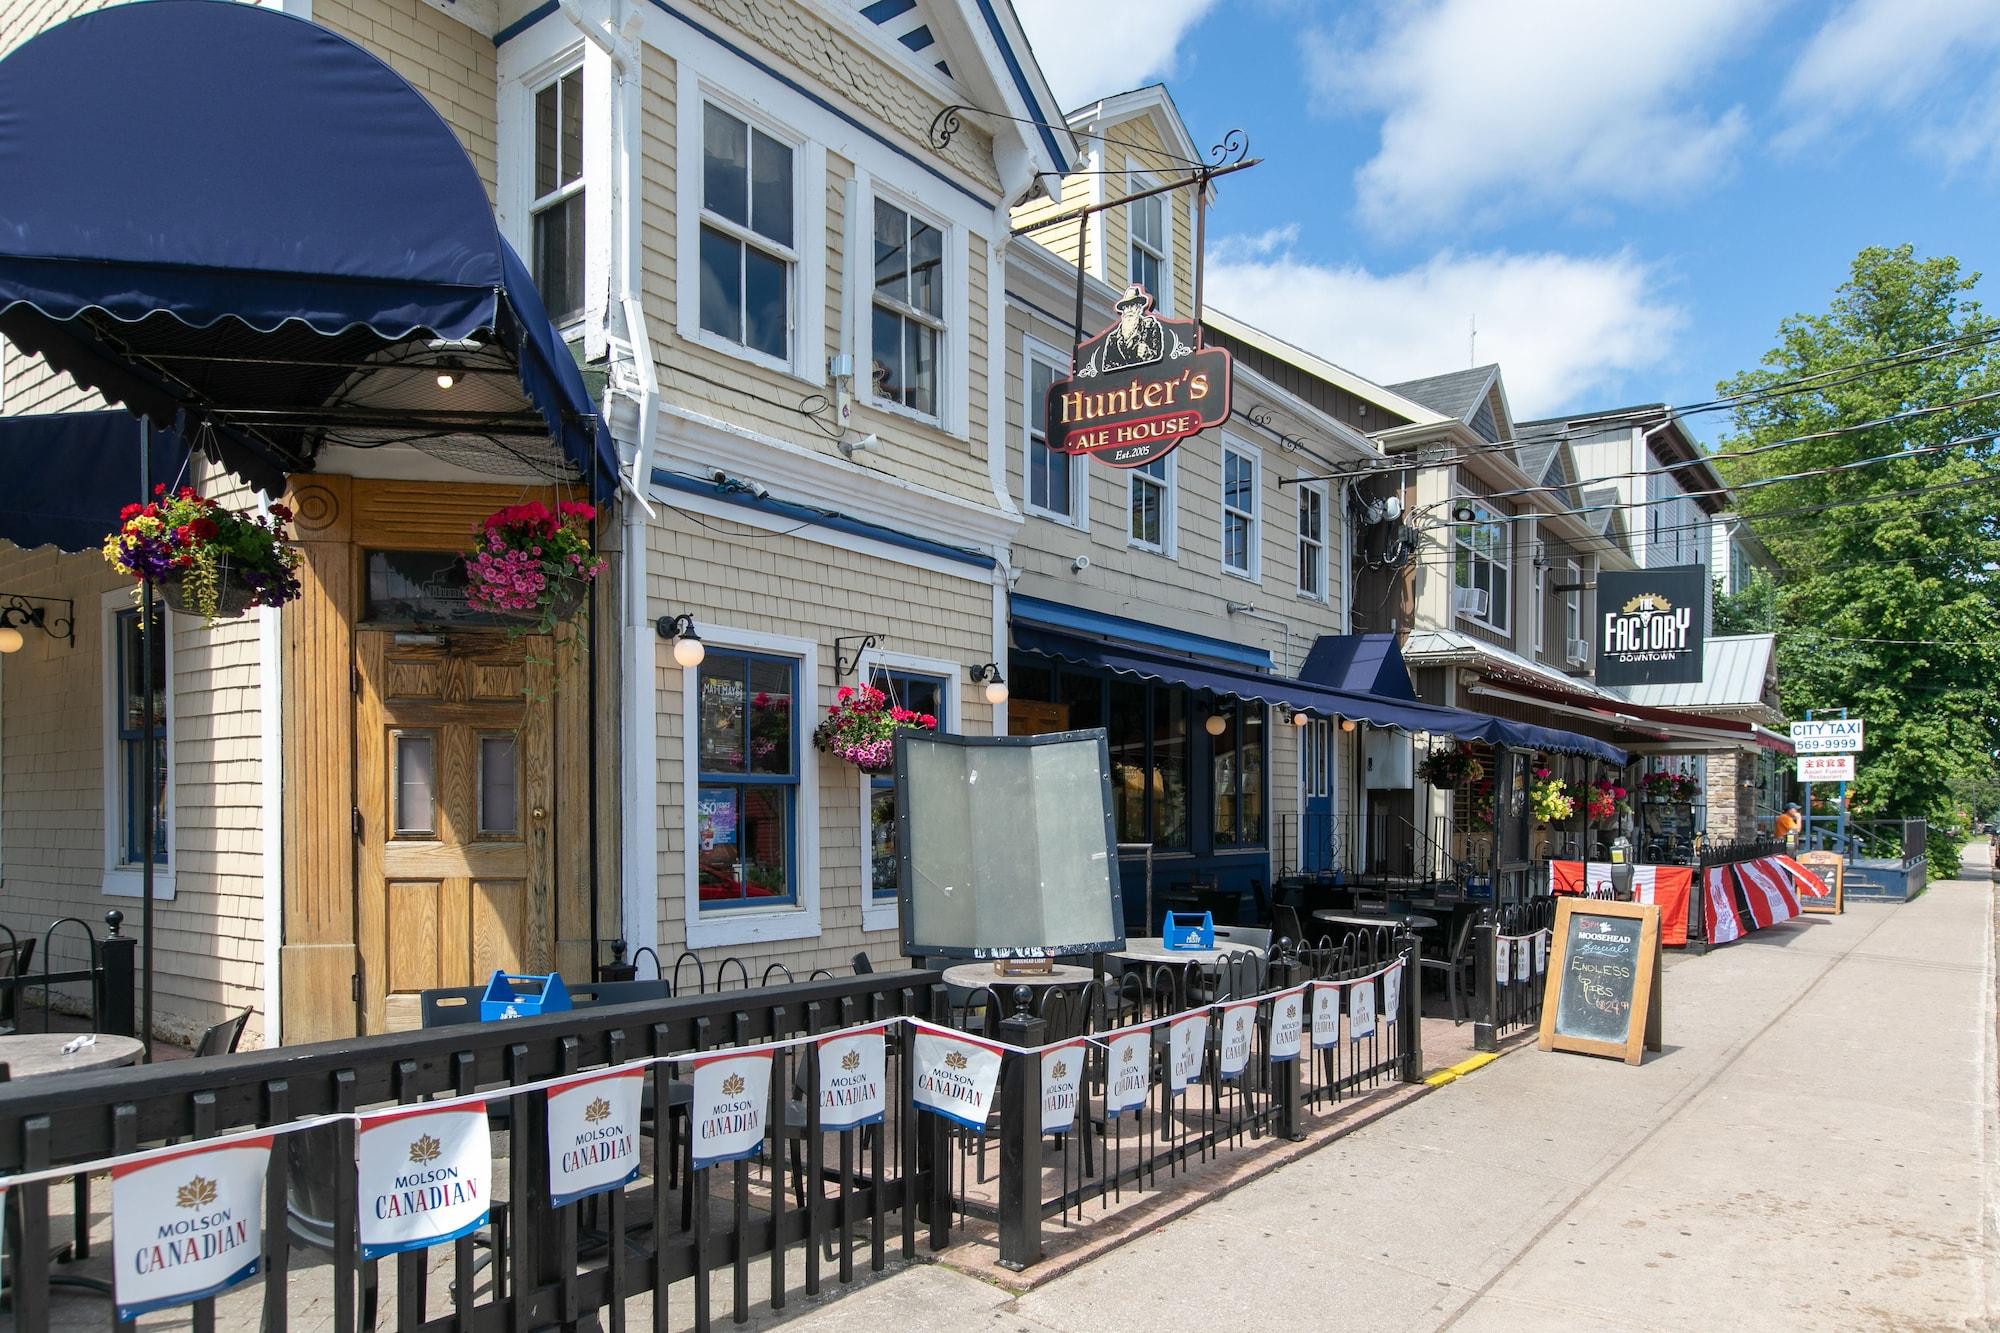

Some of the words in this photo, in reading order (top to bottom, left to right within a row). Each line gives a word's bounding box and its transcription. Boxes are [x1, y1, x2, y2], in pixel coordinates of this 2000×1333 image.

[1060, 369, 1209, 424] Hunter's
[1076, 431, 1109, 449] ALE
[1117, 416, 1190, 442] HOUSE
[1115, 445, 1150, 461] Est.2005
[1640, 598, 1654, 610] THE
[1605, 608, 1690, 652] FACTORY
[1620, 653, 1676, 663] DOWNTOWN
[1793, 724, 1824, 736] CITY
[1828, 723, 1861, 734] TAXI
[1797, 739, 1856, 749] 569-9999
[1578, 931, 1631, 943] MOOSEHEAD
[831, 1073, 866, 1087] MOLSON
[933, 1068, 975, 1086] MOLSON
[819, 1082, 876, 1107] CANADIAN
[918, 1074, 983, 1107] CANADIAN
[713, 1100, 752, 1115] MOLSON
[576, 1124, 623, 1146] MOLSON
[702, 1110, 759, 1139] CANADIAN
[562, 1133, 632, 1173] CANADIAN
[395, 1166, 458, 1190] MOLSON
[375, 1178, 479, 1221] CANADIAN
[158, 1208, 231, 1239] MOLSON
[135, 1219, 248, 1275] CANADIAN
